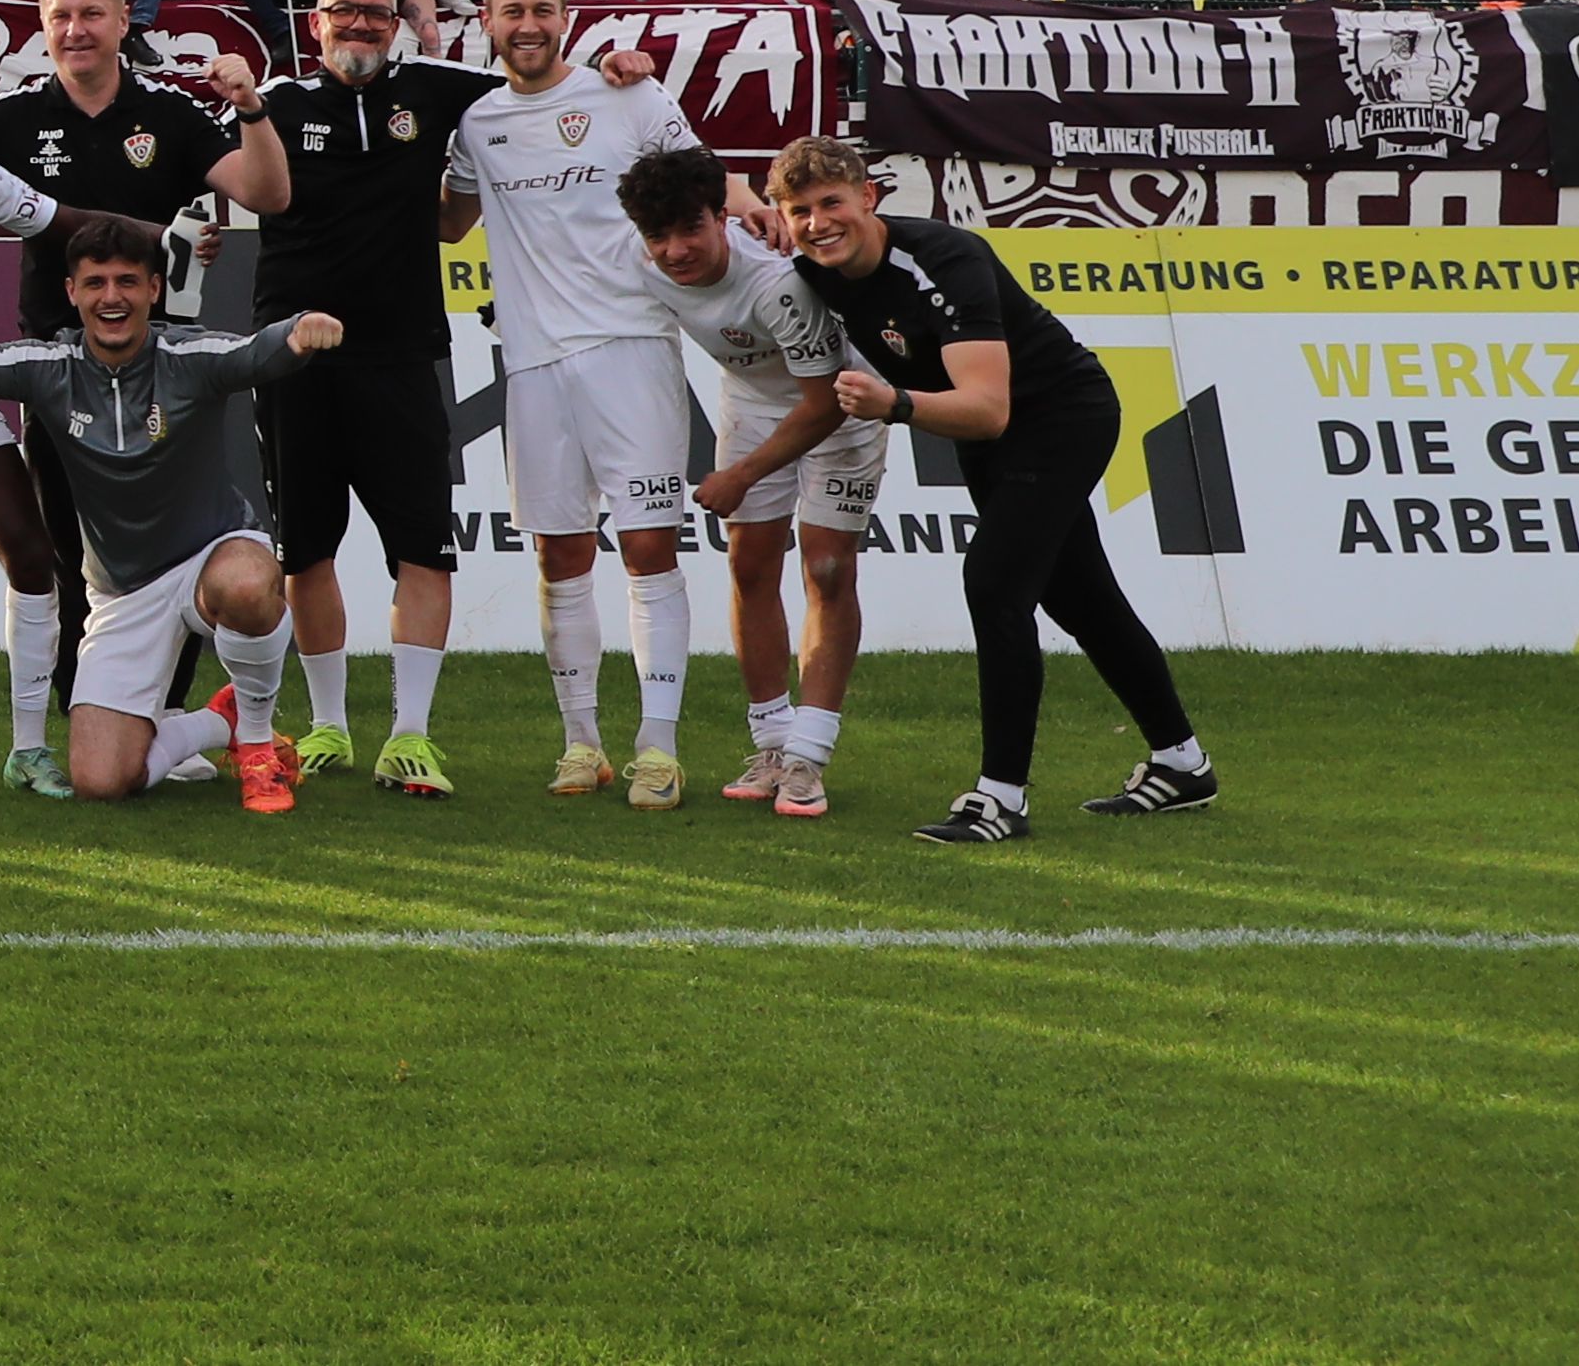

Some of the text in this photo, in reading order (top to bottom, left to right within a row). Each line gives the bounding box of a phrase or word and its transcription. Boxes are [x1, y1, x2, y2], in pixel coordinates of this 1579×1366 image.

[37, 129, 64, 140] JAKO
[302, 123, 331, 134] JAKO
[303, 134, 324, 152] UG
[1049, 120, 1275, 157] BERLINER FUSSBALL
[1030, 261, 1264, 292] BERATUNG
[1302, 342, 1579, 398] WERKZ
[1318, 421, 1456, 476] DIE
[645, 500, 673, 511] JAKO
[836, 503, 864, 514] JAKO
[551, 669, 579, 678] AKO
